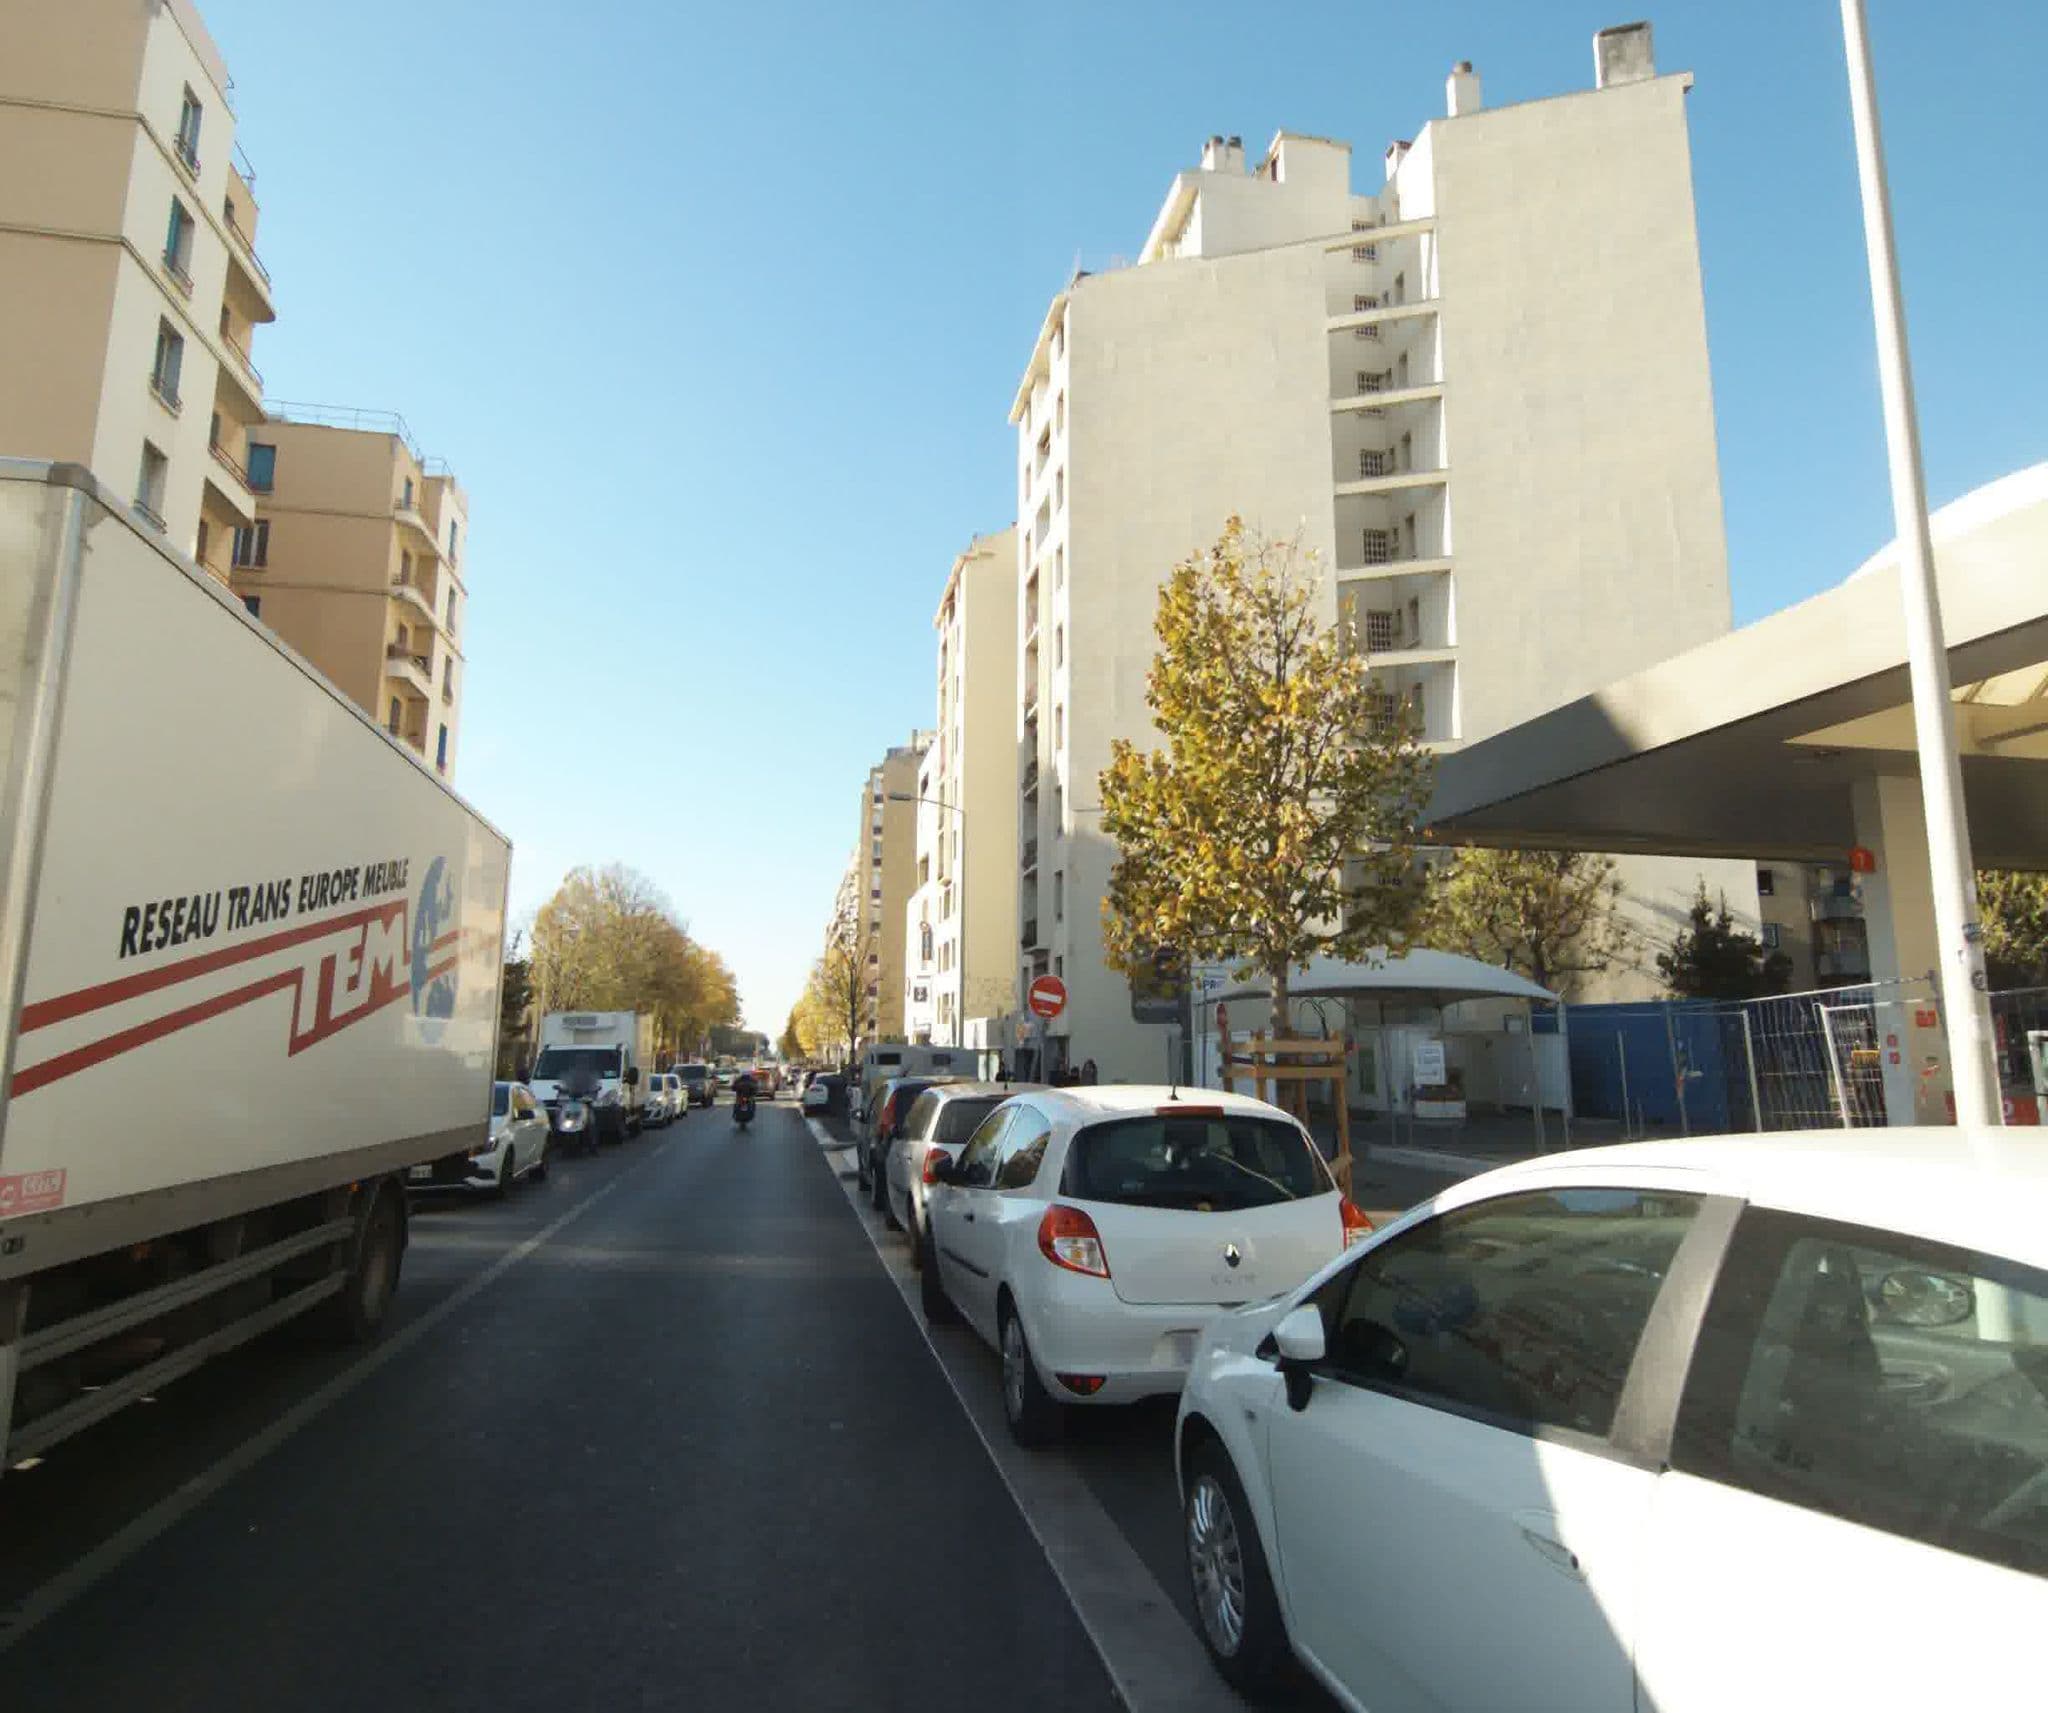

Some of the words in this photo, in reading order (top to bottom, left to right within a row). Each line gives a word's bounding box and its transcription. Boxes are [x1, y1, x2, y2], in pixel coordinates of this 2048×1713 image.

[119, 891, 221, 959] RESEAU
[227, 878, 292, 931] TRANS
[298, 867, 360, 913] EUROPE
[362, 858, 409, 897] MEUBLE
[293, 908, 410, 1040] TEM
